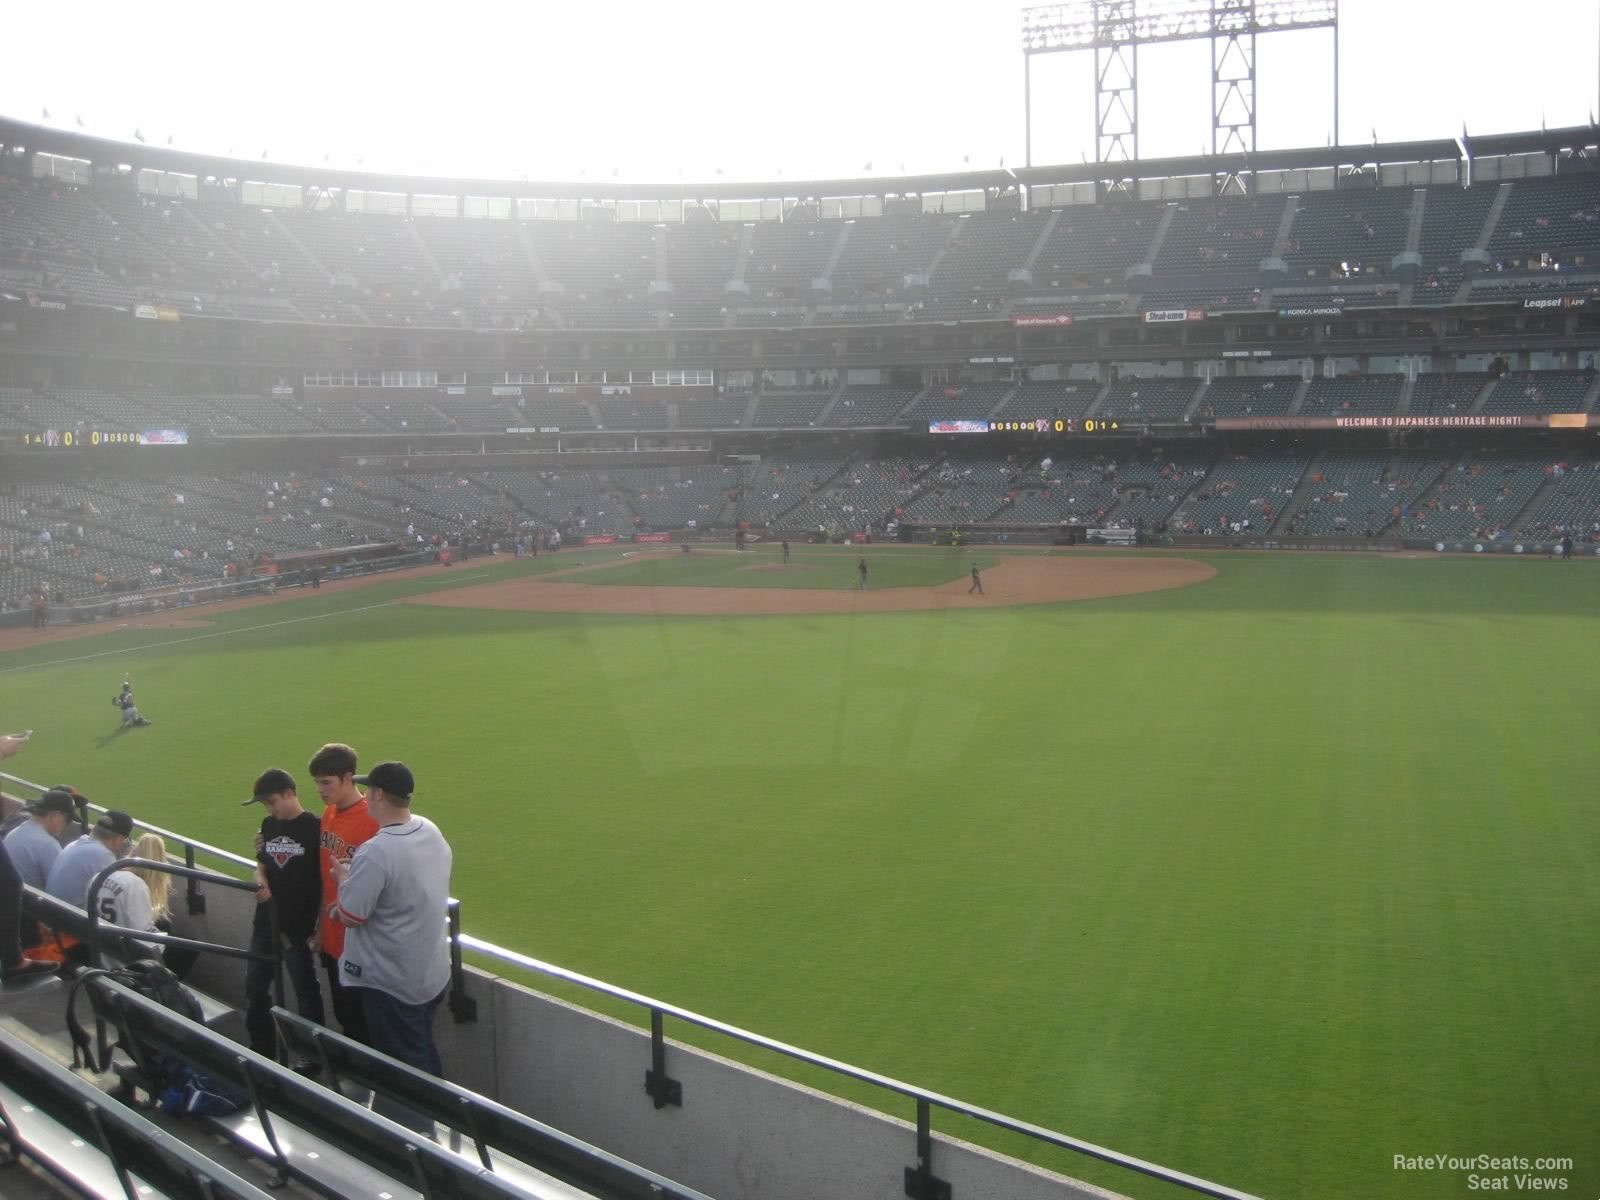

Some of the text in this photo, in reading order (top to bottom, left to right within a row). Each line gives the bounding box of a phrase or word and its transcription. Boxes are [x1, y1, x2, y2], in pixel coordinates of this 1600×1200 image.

[1336, 416, 1522, 427] WELCOME TO JAPANESE HERITAGE NIGHT!
